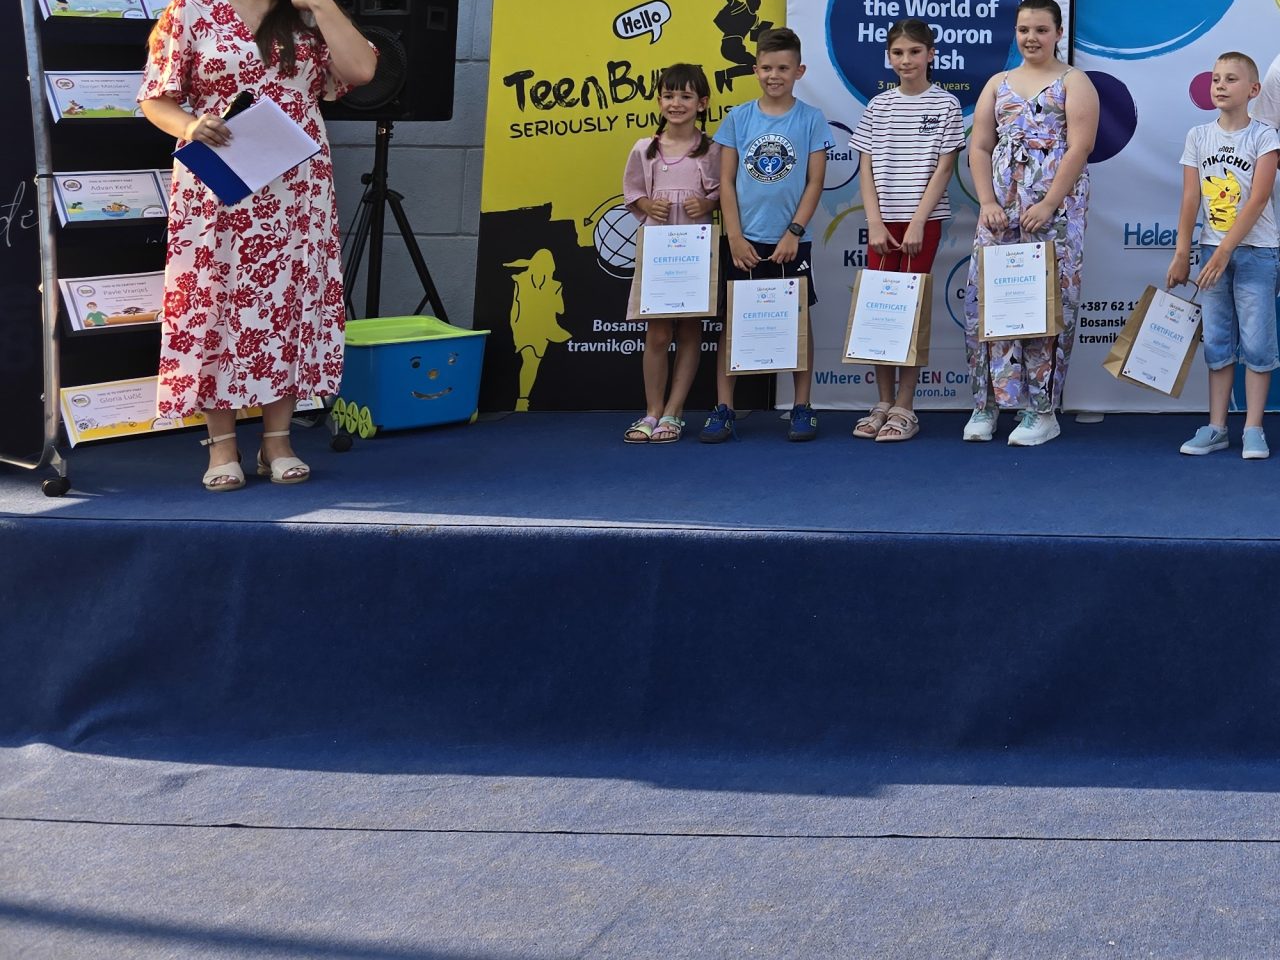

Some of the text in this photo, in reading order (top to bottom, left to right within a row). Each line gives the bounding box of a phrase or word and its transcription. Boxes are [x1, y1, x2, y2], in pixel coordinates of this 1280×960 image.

[621, 9, 662, 34] Hello
[877, 81, 884, 90] 3
[943, 81, 970, 91] years
[510, 115, 619, 139] SERIOUSLY
[826, 149, 853, 161] sical
[1202, 154, 1251, 171] PIKACHU
[653, 255, 700, 263] CERTIFICATE
[994, 275, 1036, 285] CERTIFICATE
[865, 301, 908, 312] CERTIFICATE
[1080, 301, 1108, 311] +387
[1110, 301, 1124, 311] 62
[743, 311, 789, 319] CERTIFICATE
[593, 319, 649, 332] Bosans
[1080, 316, 1127, 328] Bosansk
[1079, 333, 1119, 344] travnik
[1150, 322, 1185, 343] CERTIFICATE
[815, 371, 861, 384] Where
